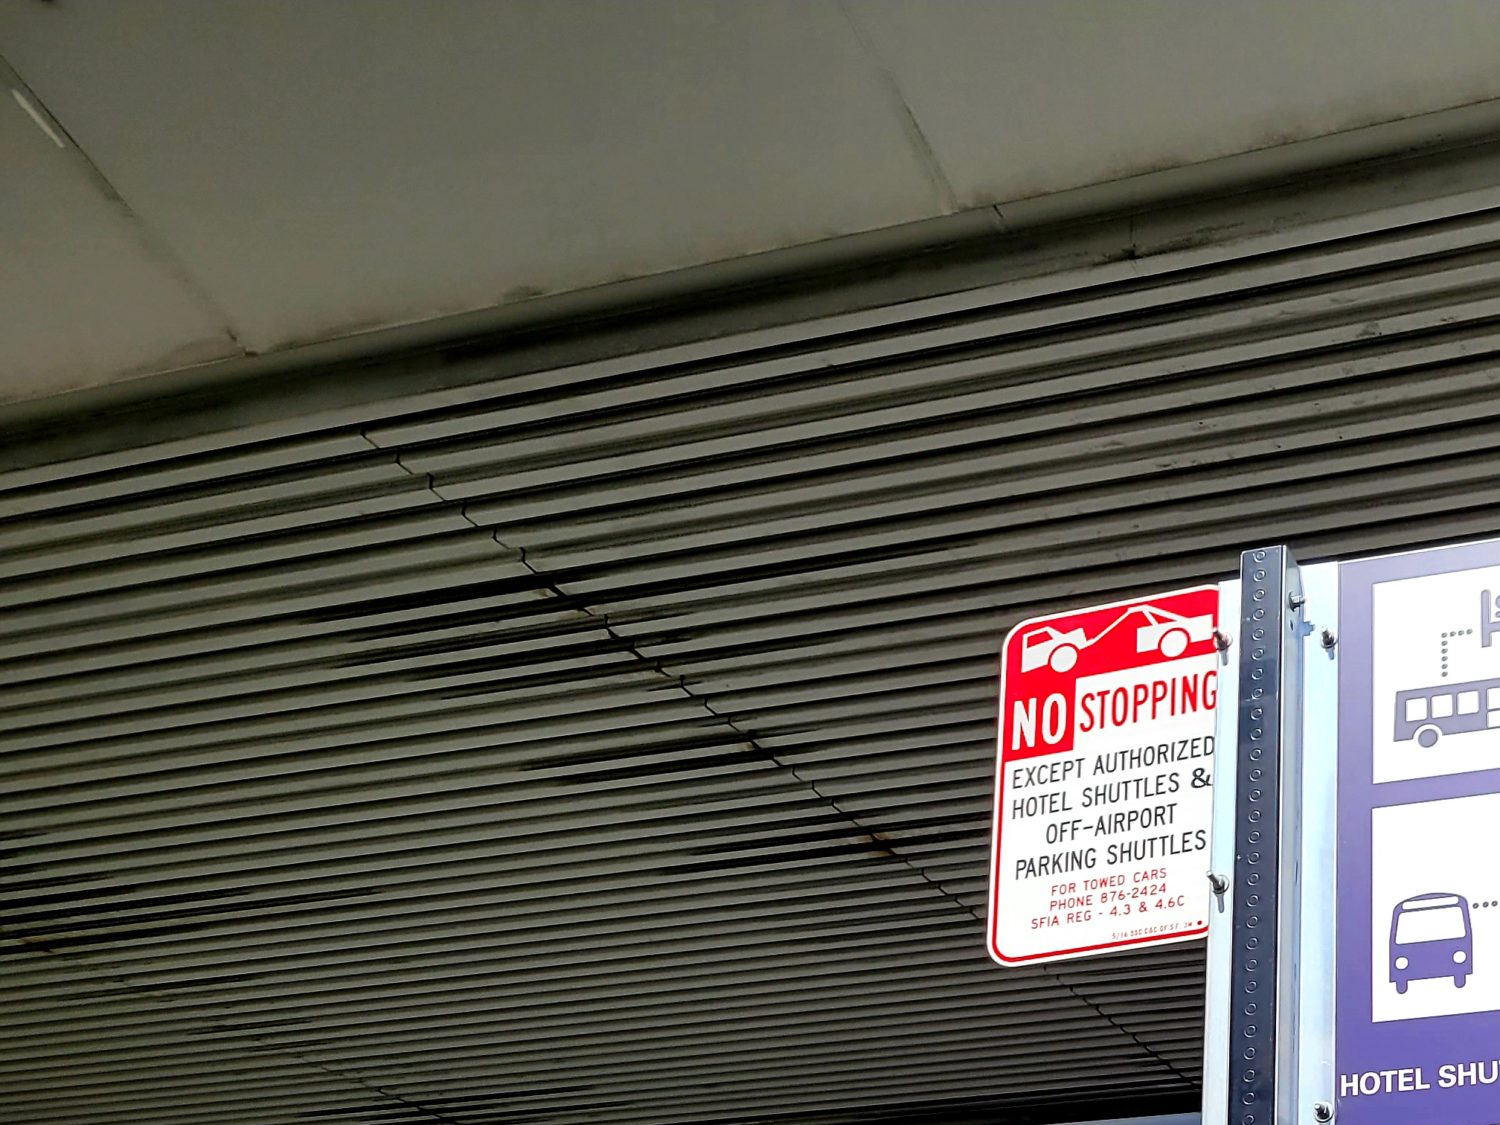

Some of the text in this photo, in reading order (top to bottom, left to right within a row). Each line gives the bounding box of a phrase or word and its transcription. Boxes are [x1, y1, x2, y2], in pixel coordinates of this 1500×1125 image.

[1011, 670, 1217, 751] NO STOPPING
[1012, 735, 1215, 789] EXCEPT AUTHORIZED
[1012, 767, 1213, 820] HOTEL SHUTTLES &
[1046, 803, 1178, 845] OFF-AIRPORT
[1015, 829, 1206, 880] PARKING SHUTTLES
[1050, 883, 1167, 911] PHONE 876-2424
[1051, 868, 1167, 896] FOR TOWED CARS
[1031, 915, 1060, 930] SFIA
[1066, 911, 1092, 924] REG
[1109, 904, 1131, 917] 4.3
[1138, 901, 1148, 912] &
[1155, 895, 1185, 910] 4.6C
[1340, 1067, 1431, 1097] HOTEL
